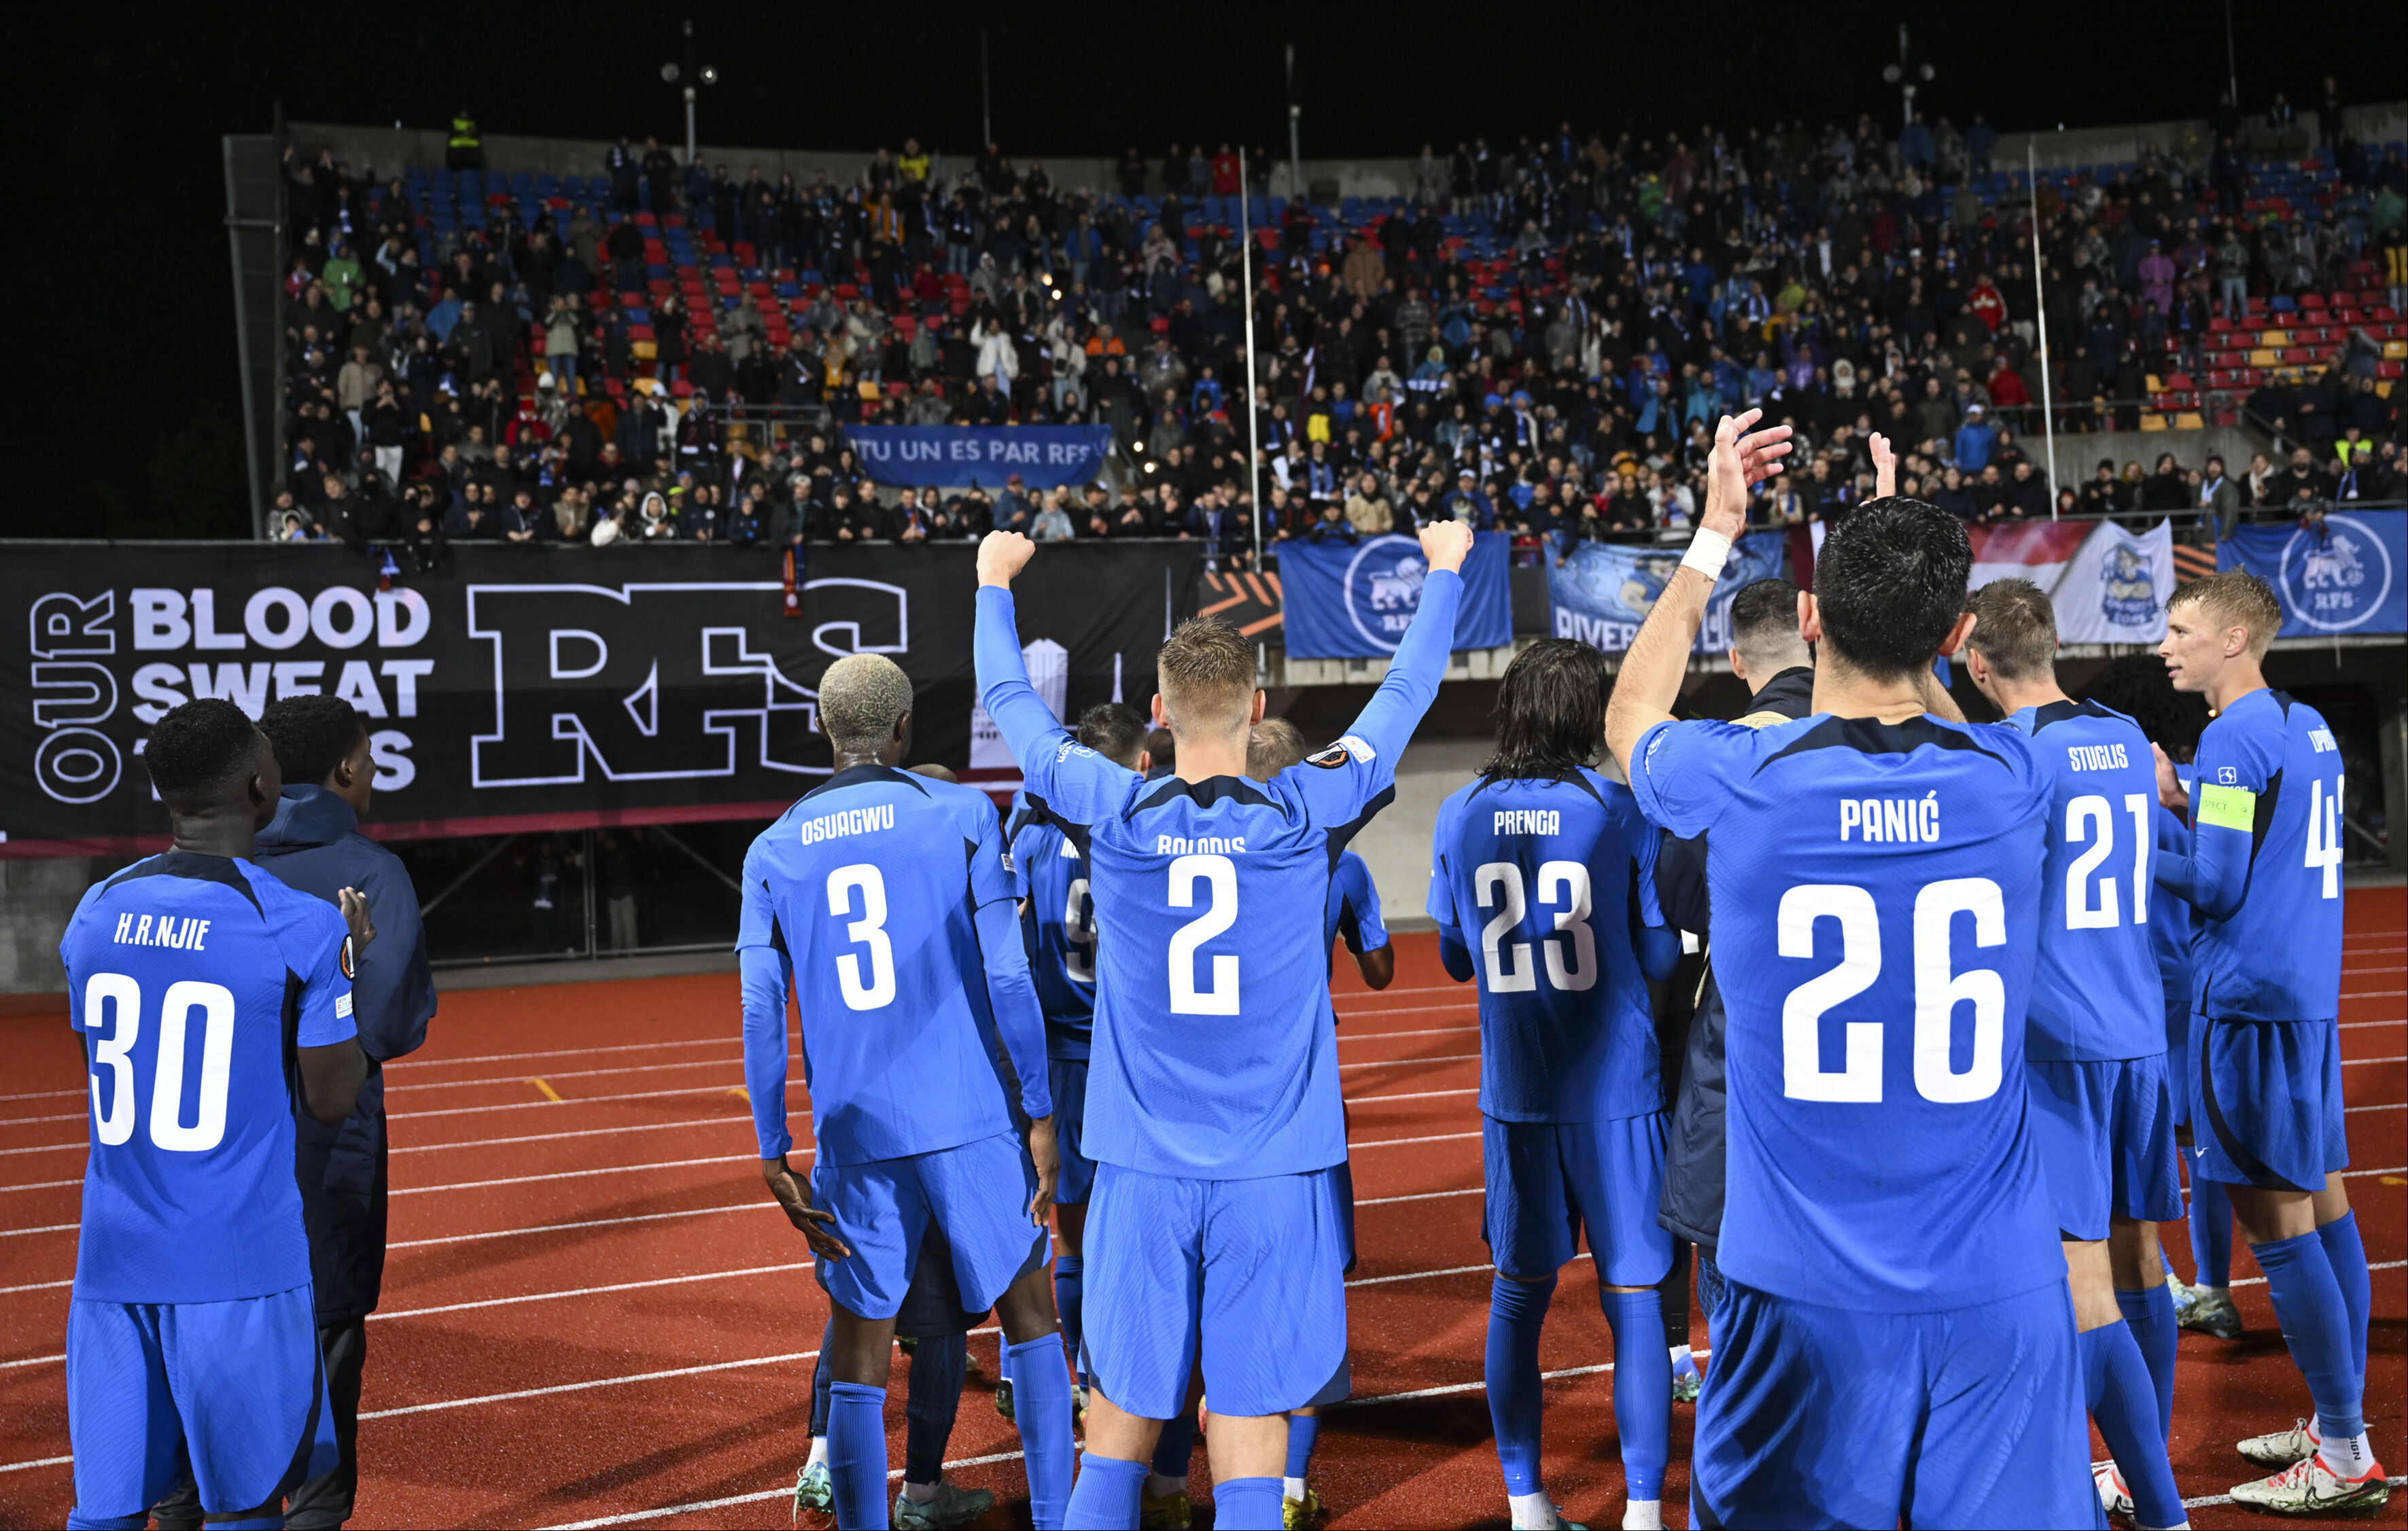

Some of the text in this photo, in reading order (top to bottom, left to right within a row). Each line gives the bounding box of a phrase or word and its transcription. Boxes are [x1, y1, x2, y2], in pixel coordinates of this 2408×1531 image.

[856, 440, 891, 461] TU
[900, 440, 941, 461] UN
[952, 439, 981, 461] ES
[990, 442, 1040, 463] PAR
[129, 585, 431, 650] BLOOD
[1382, 614, 1416, 631] RF
[30, 588, 122, 804] OUR
[132, 659, 435, 725] SWEAT
[467, 578, 908, 788] RFS
[2067, 743, 2129, 772] STUGLIS
[801, 804, 894, 846] OSUAGWU
[1494, 810, 1560, 836] PRENGA
[1840, 790, 1940, 843] PANIĆ
[2065, 793, 2149, 930] 21
[114, 913, 211, 951] H.R.NJIE
[826, 863, 896, 1011] 3
[1168, 854, 1240, 1016] 2
[1474, 860, 1597, 993] 23
[1777, 877, 2007, 1104] 26
[84, 972, 235, 1152] 30
